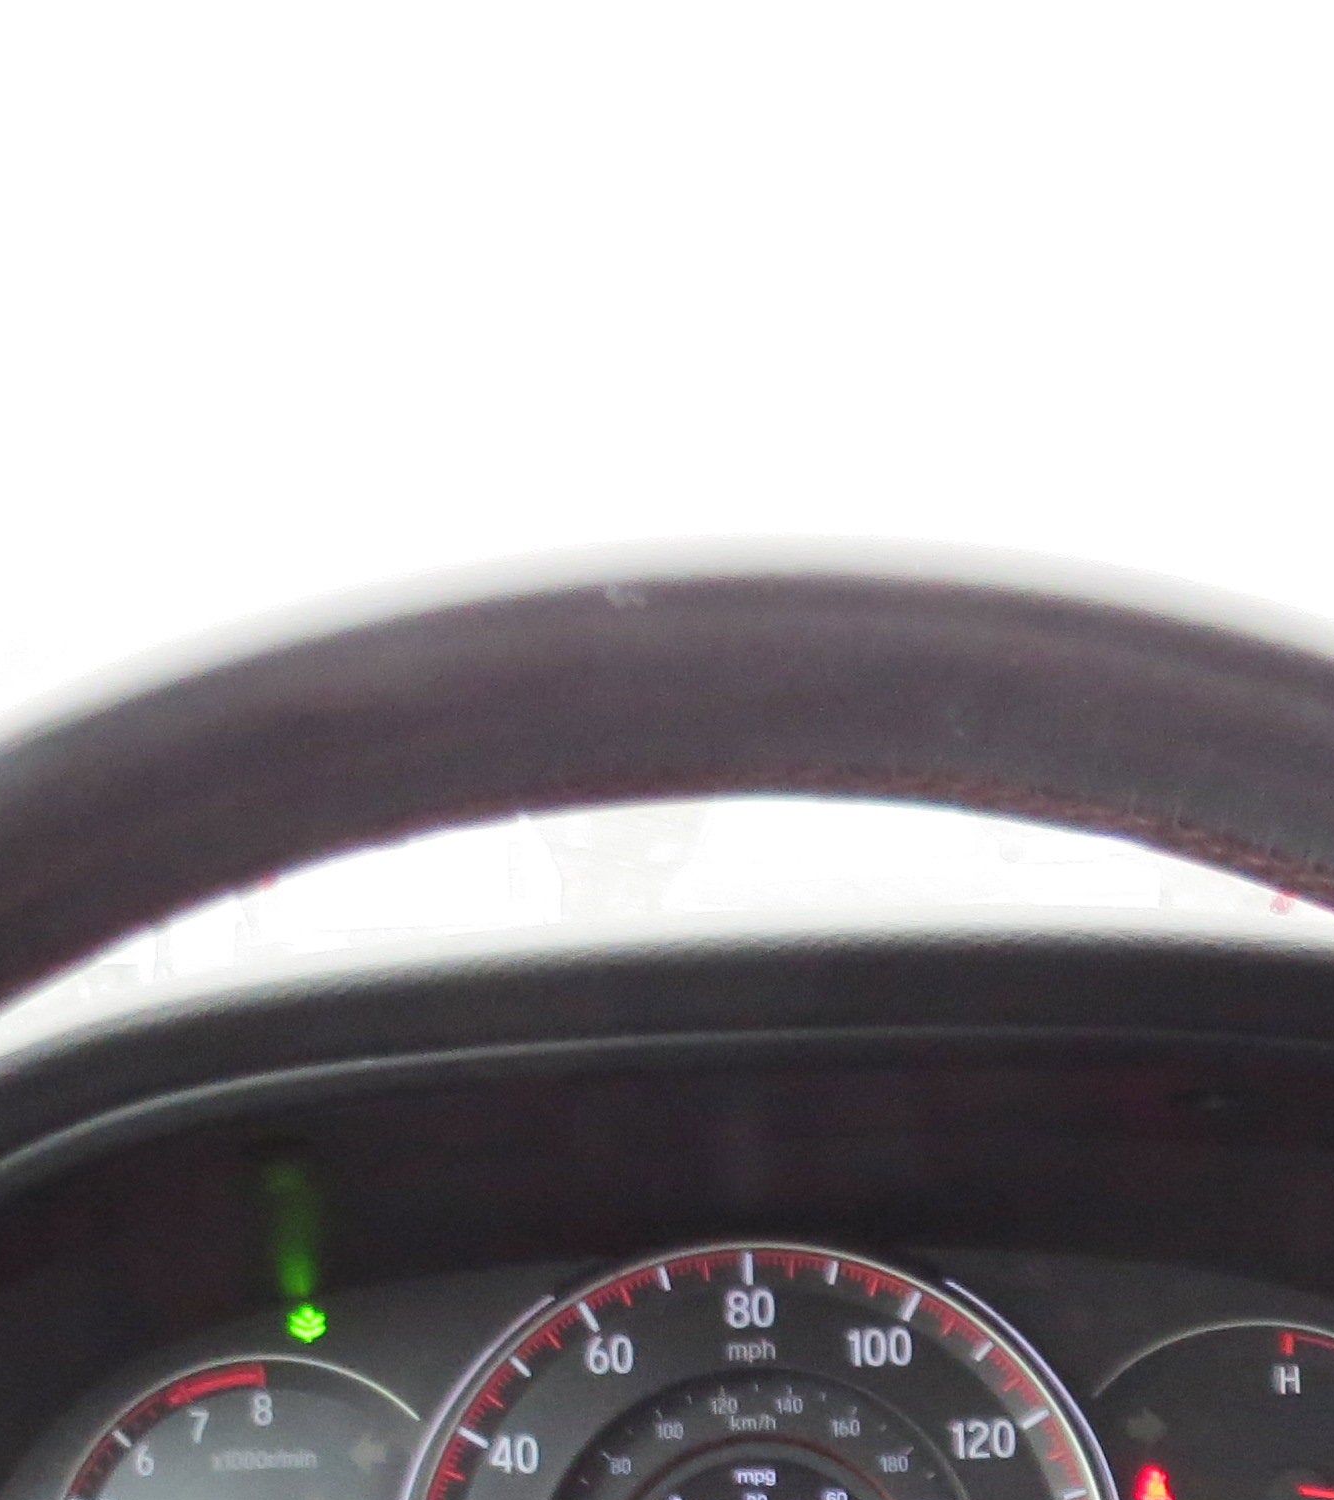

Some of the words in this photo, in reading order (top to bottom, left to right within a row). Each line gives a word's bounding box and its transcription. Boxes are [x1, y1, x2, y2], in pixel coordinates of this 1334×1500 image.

[725, 1290, 775, 1329] 80
[585, 1336, 634, 1375] 60
[727, 1340, 777, 1364] mph
[848, 1329, 913, 1368] 100
[1275, 1365, 1301, 1395] H
[190, 1409, 210, 1443] 7
[250, 1394, 274, 1427] 8
[729, 1413, 777, 1431] km/h
[490, 1434, 540, 1474] 40
[952, 1419, 1016, 1461] 120
[135, 1445, 155, 1477] 6
[734, 1468, 777, 1487] mpg
